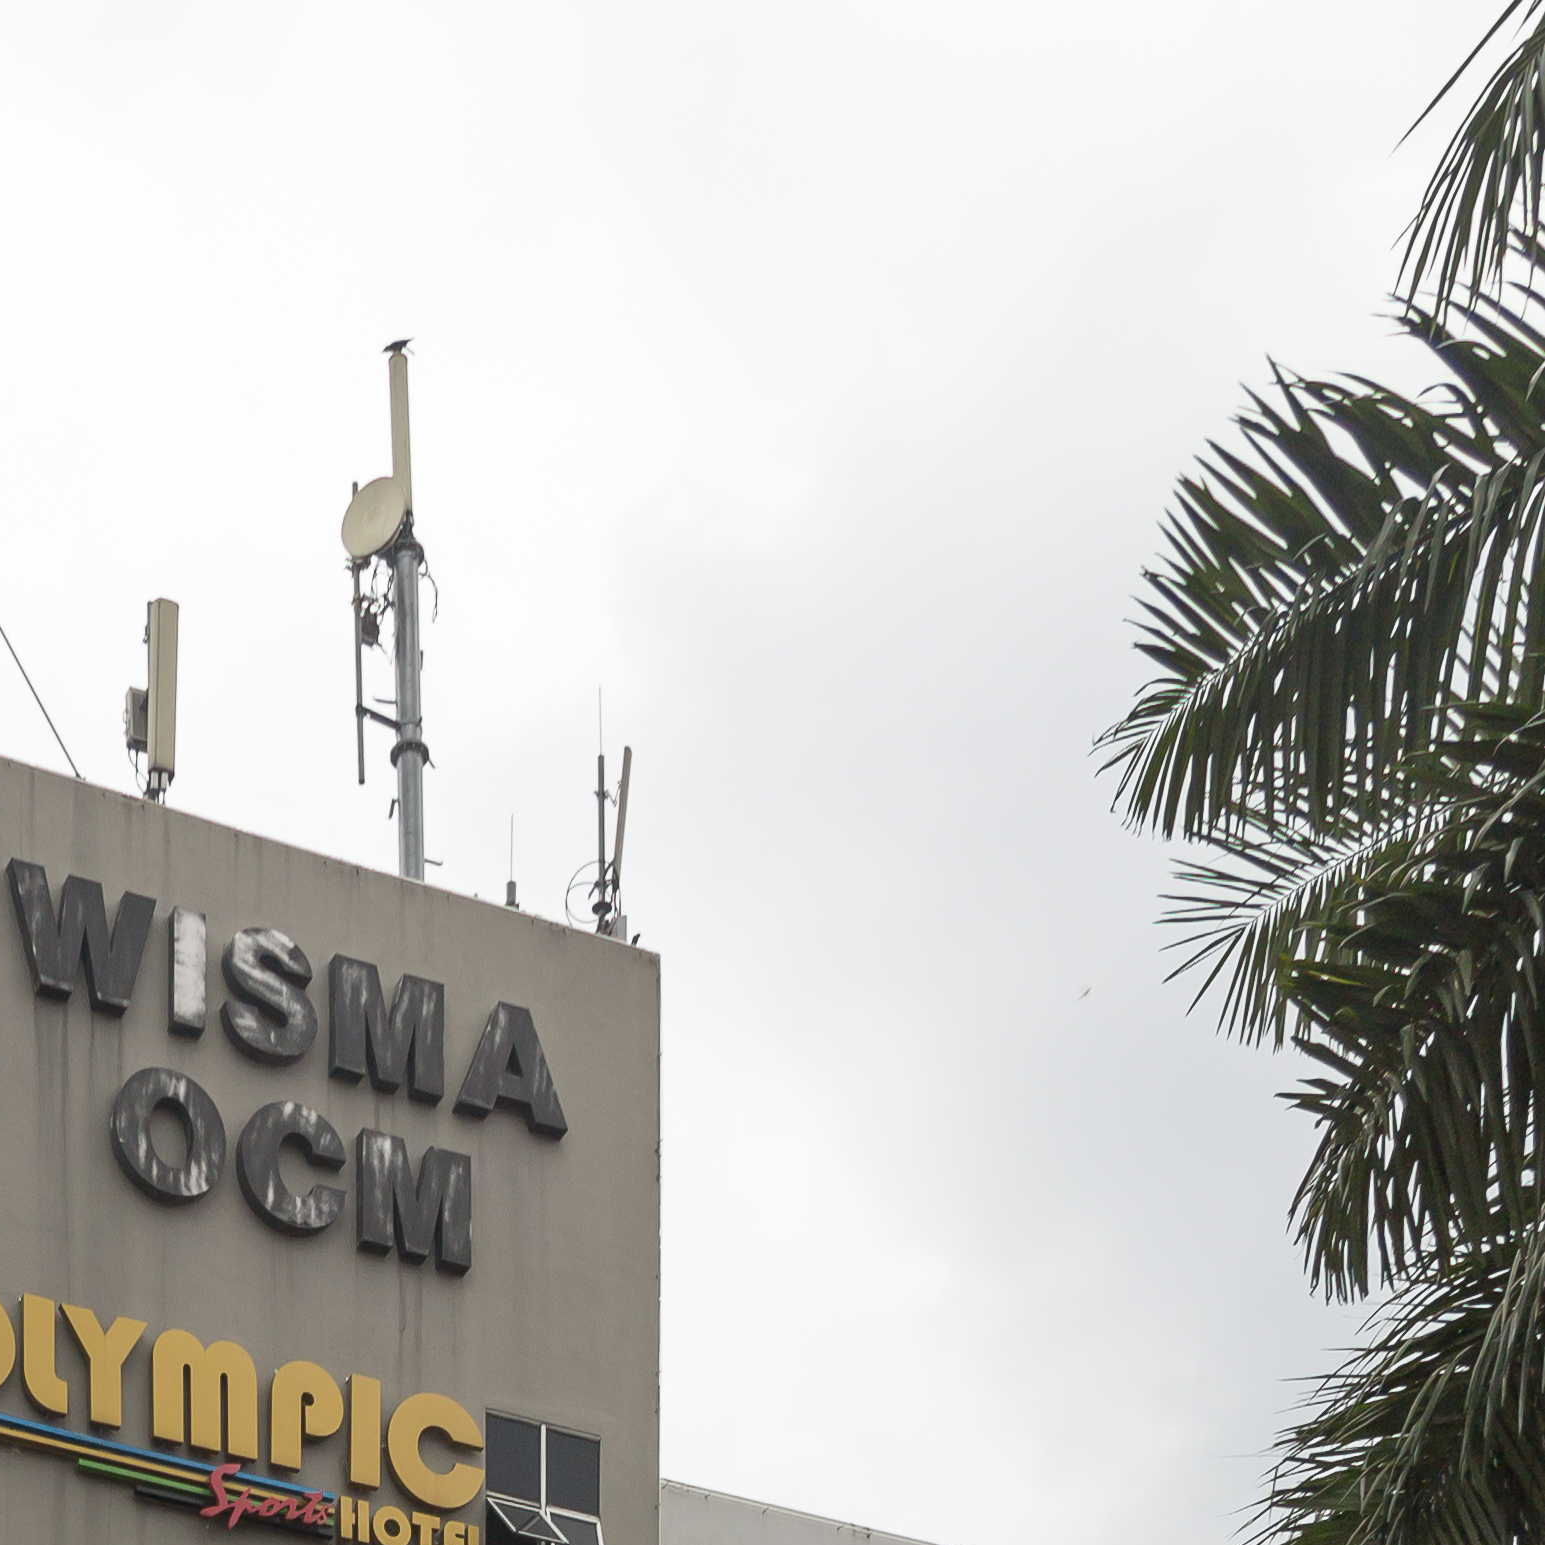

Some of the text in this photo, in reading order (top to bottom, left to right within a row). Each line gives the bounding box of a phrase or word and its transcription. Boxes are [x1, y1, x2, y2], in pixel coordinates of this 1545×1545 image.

[4, 857, 569, 1142] WISMA
[109, 1067, 473, 1277] OCM
[200, 1463, 330, 1530] Sports
